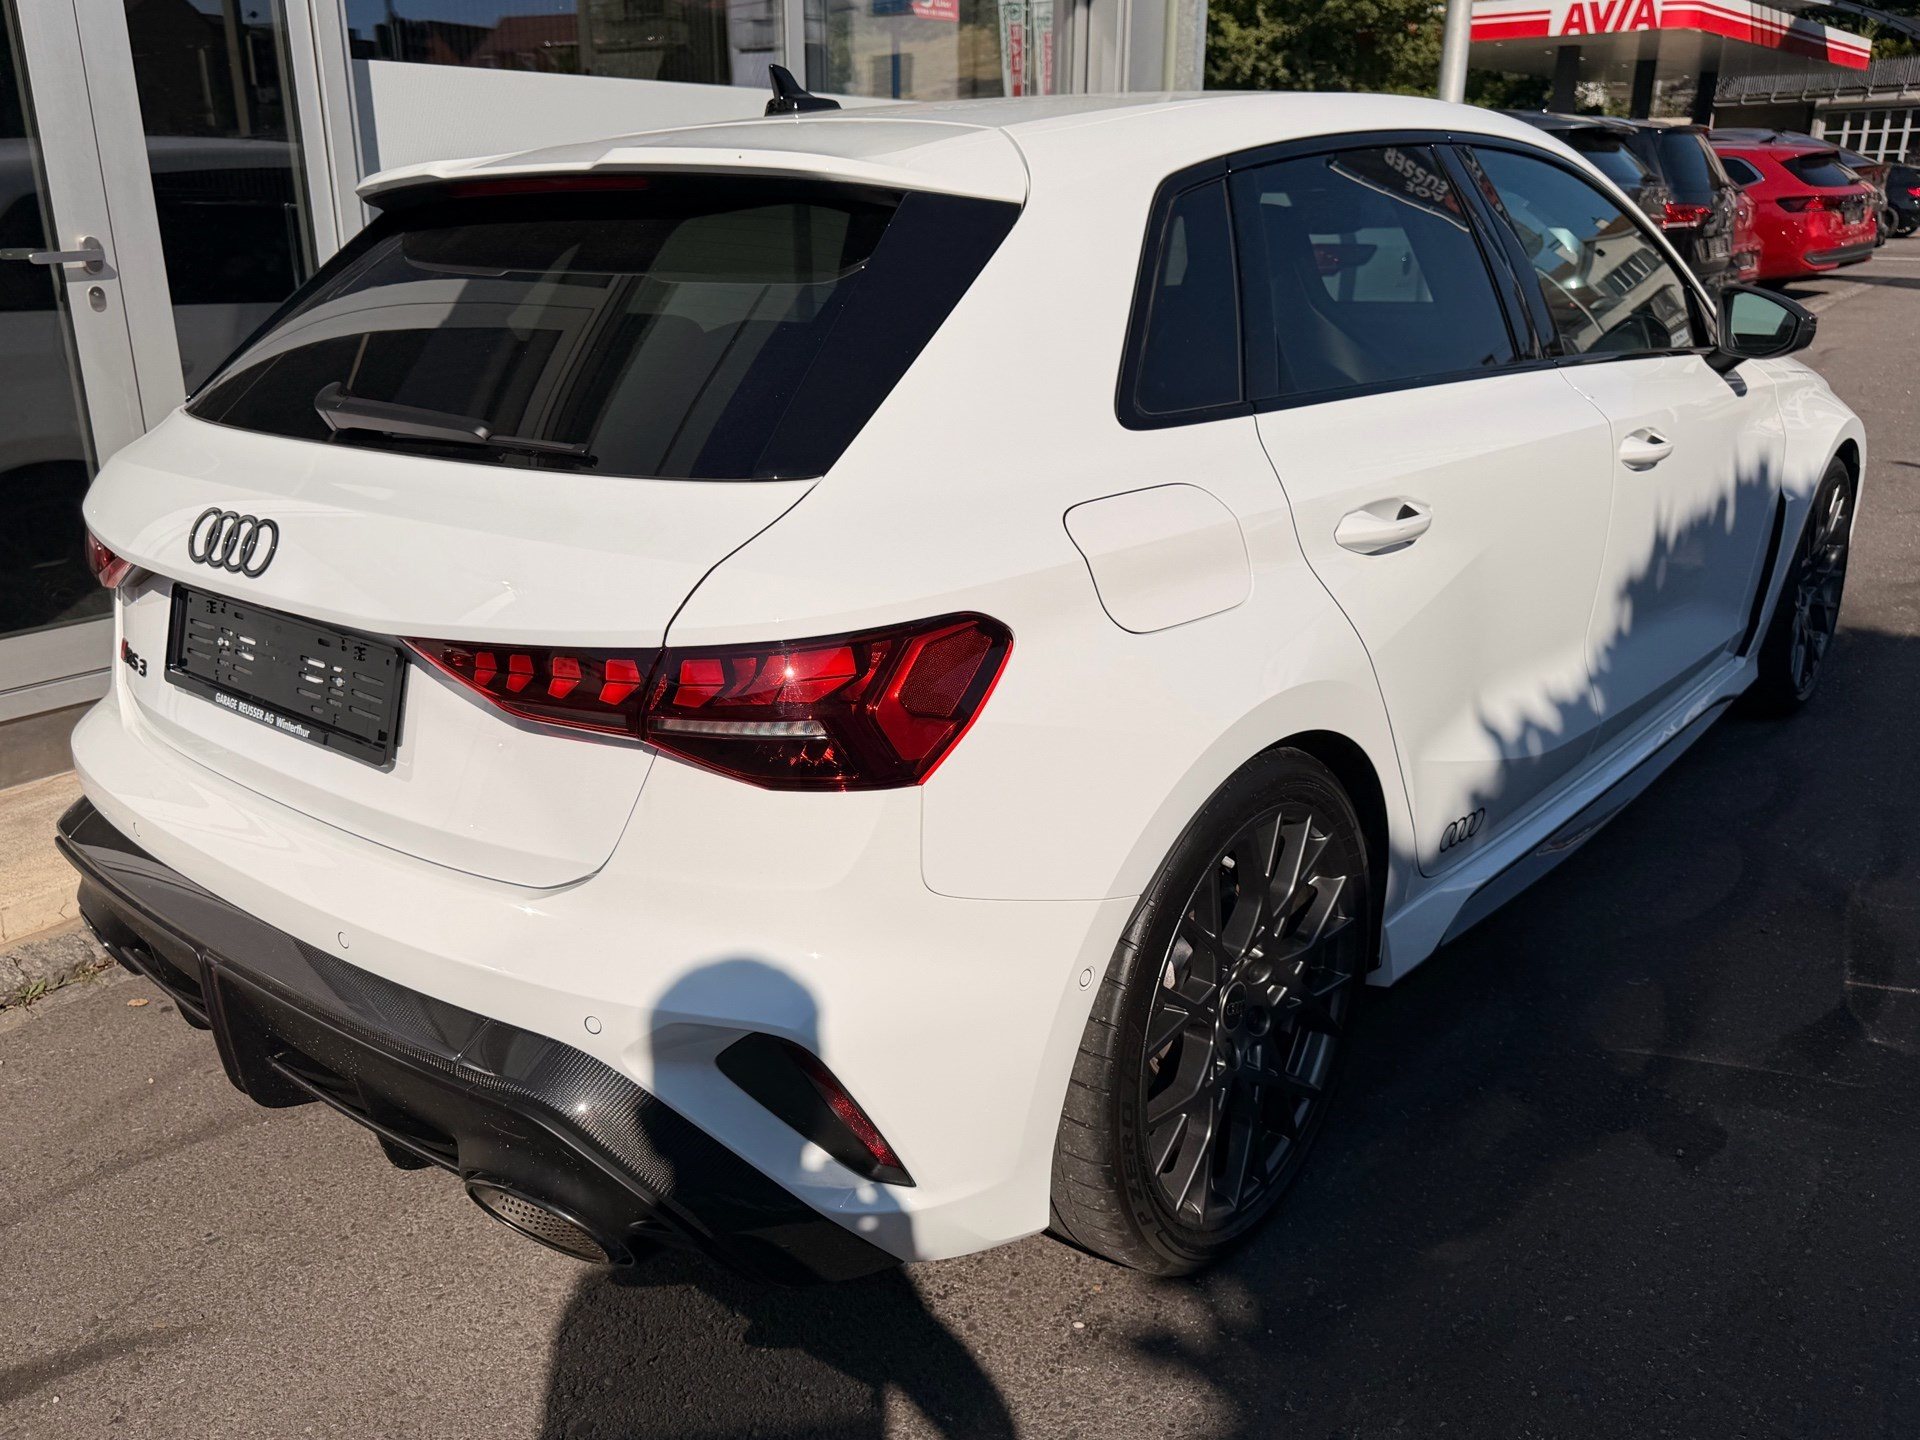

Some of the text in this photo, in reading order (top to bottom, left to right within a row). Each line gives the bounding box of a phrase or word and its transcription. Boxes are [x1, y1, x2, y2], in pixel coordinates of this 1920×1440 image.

[1560, 0, 1658, 36] AVIA
[1384, 148, 1449, 195] EUSSER
[215, 692, 311, 738] GARAGE REUSSER AG Winterthur
[1121, 1102, 1144, 1203] ZERO
